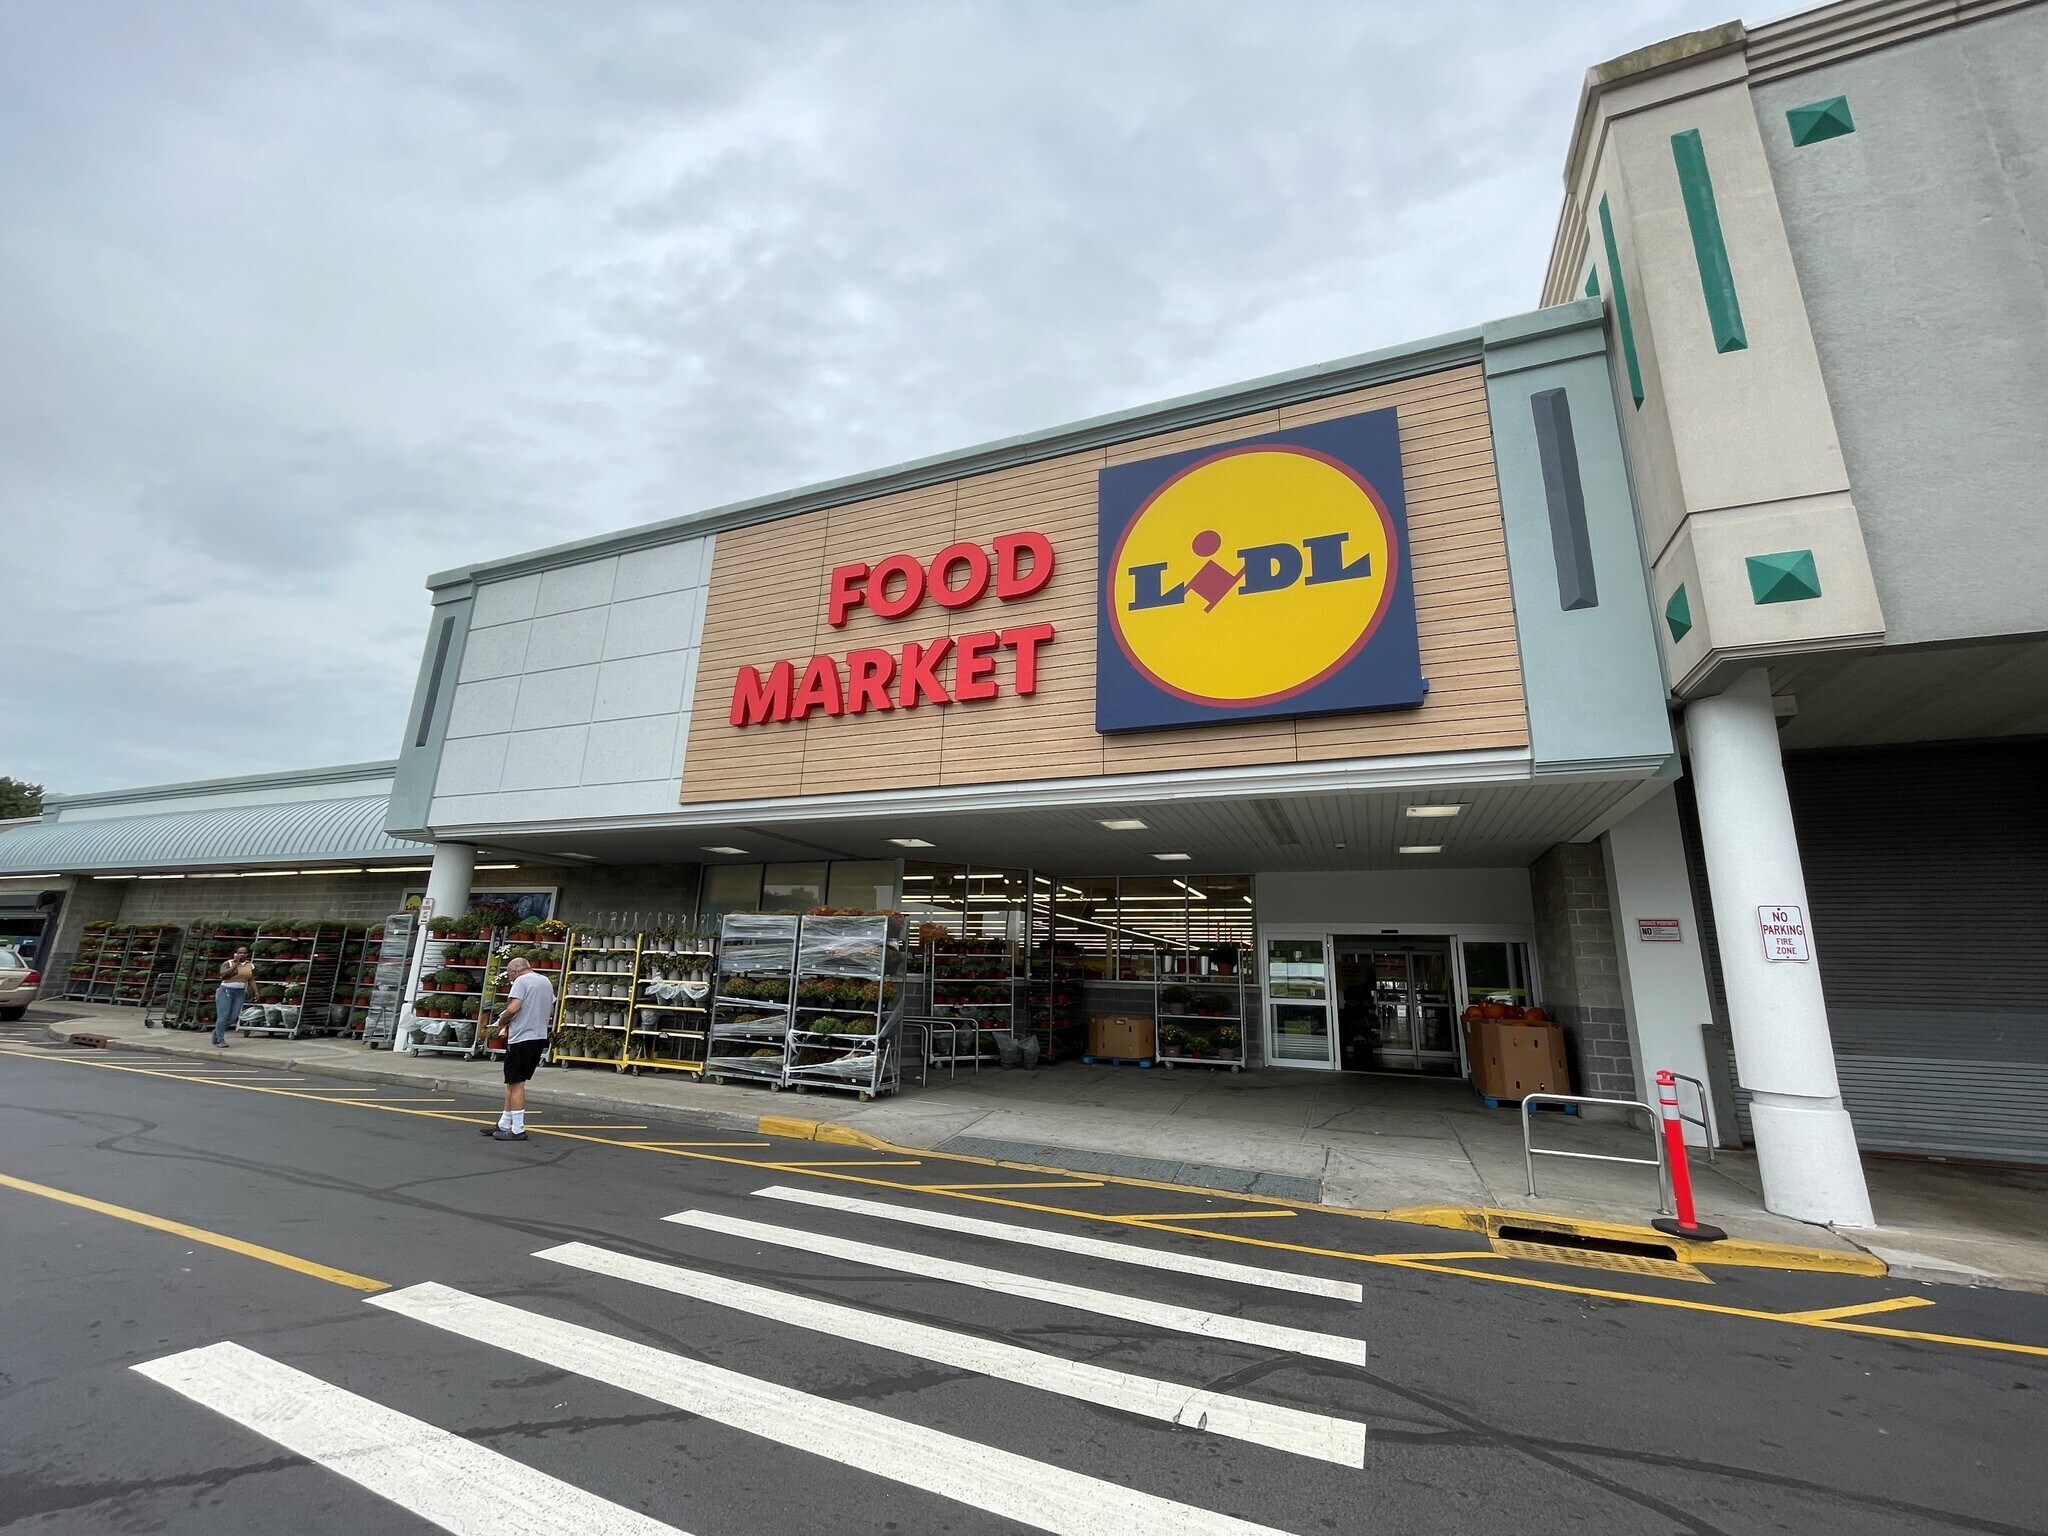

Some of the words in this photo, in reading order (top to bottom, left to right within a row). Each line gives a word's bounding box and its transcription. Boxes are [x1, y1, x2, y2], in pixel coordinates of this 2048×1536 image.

[828, 531, 1055, 628] FOOD
[730, 623, 1055, 728] MARKET
[1772, 911, 1788, 923] NO
[1641, 927, 1653, 935] NO
[1763, 924, 1803, 936] PARKING
[1776, 937, 1794, 946] FIRE
[1776, 946, 1798, 955] ZONE
